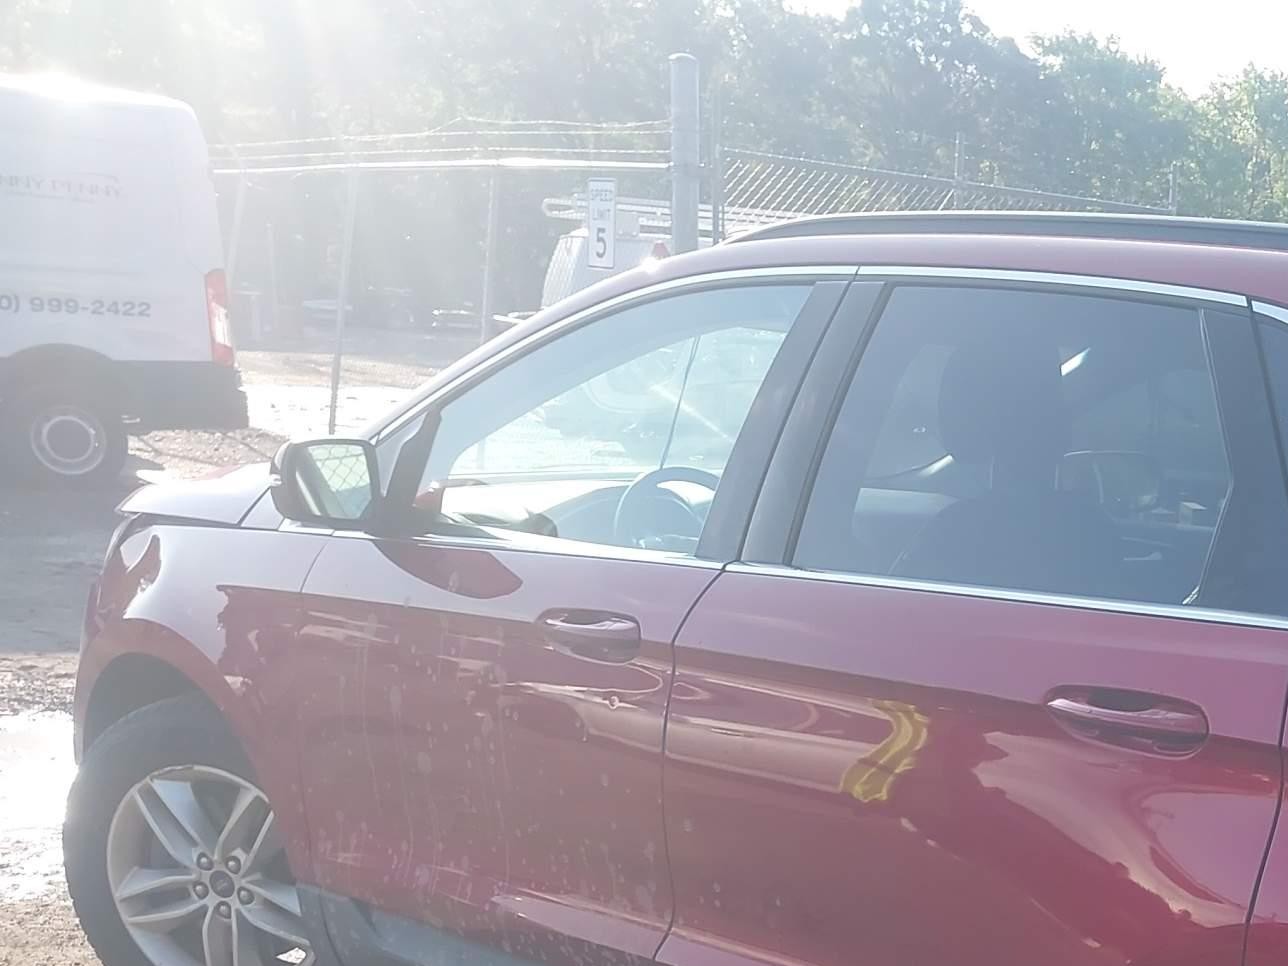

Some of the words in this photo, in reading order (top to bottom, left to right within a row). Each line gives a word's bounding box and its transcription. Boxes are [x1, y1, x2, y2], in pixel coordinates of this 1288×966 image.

[591, 188, 613, 202] SPEED
[596, 227, 607, 259] 5
[29, 296, 151, 317] 999-2422
